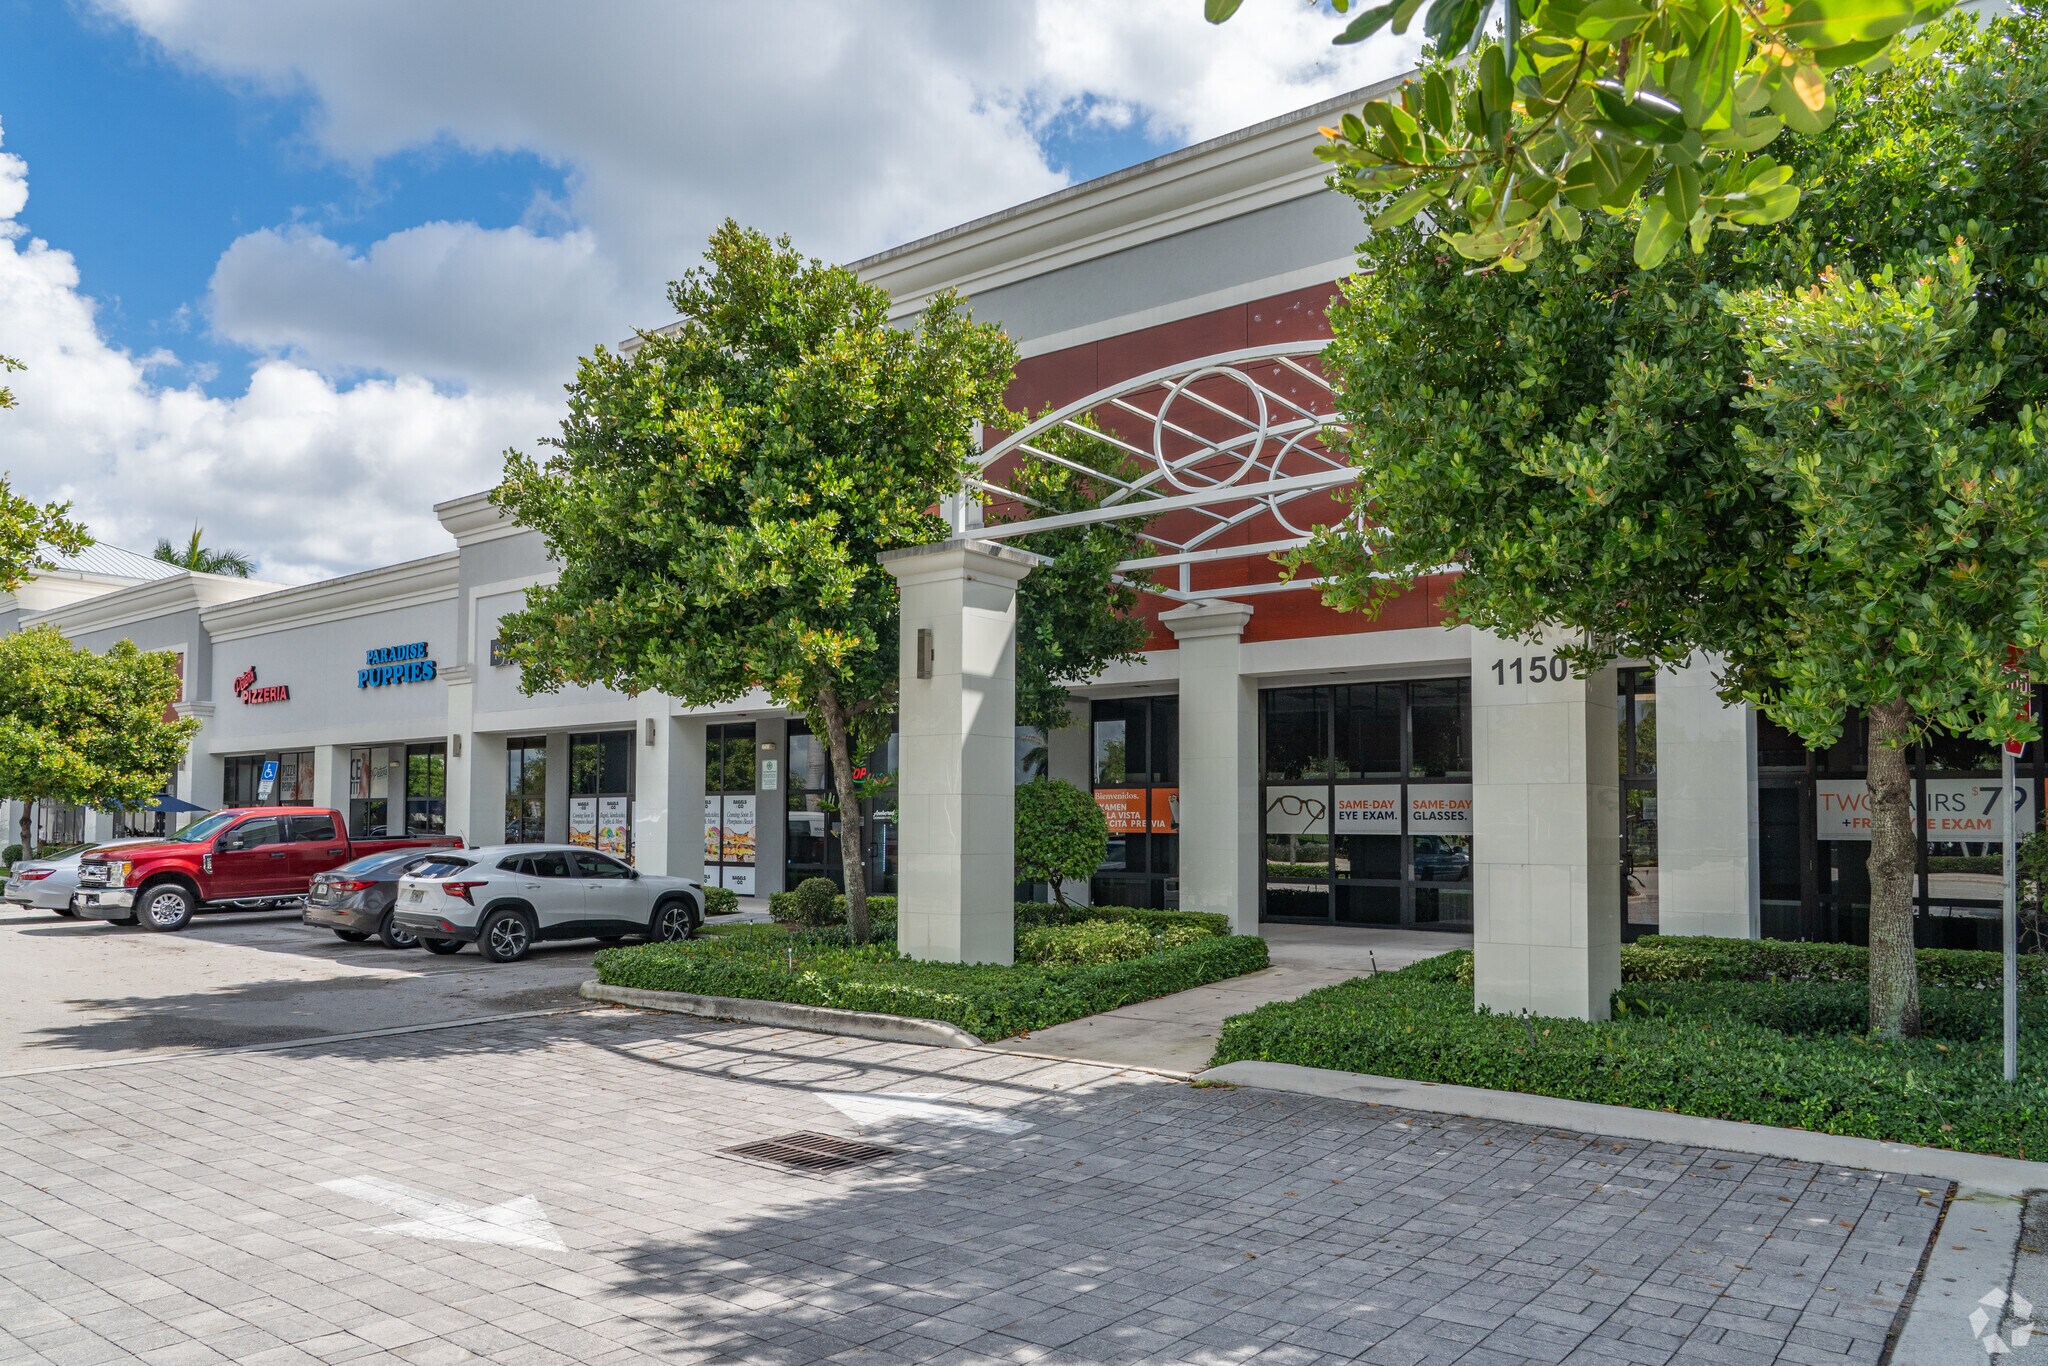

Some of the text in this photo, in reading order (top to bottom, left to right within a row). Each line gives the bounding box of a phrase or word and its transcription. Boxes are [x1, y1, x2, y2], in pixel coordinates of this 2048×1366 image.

[366, 642, 427, 665] PARADISE
[358, 660, 435, 688] PUPPIES
[1491, 654, 1568, 685] 1150
[242, 686, 288, 704] PIZZERIA
[282, 764, 296, 777] PIZZA
[1094, 792, 1140, 800] Bienvenidos.
[1099, 803, 1127, 811] XAMEN
[1338, 800, 1395, 809] SAME-DAY
[1412, 800, 1473, 809] SAME-DAY
[1106, 811, 1140, 819] LA VISTA
[1339, 811, 1398, 820] EYE EXAM.
[1413, 811, 1468, 820] GLASSES.
[1109, 820, 1128, 828] CITA
[1941, 819, 1992, 830] EXAM
